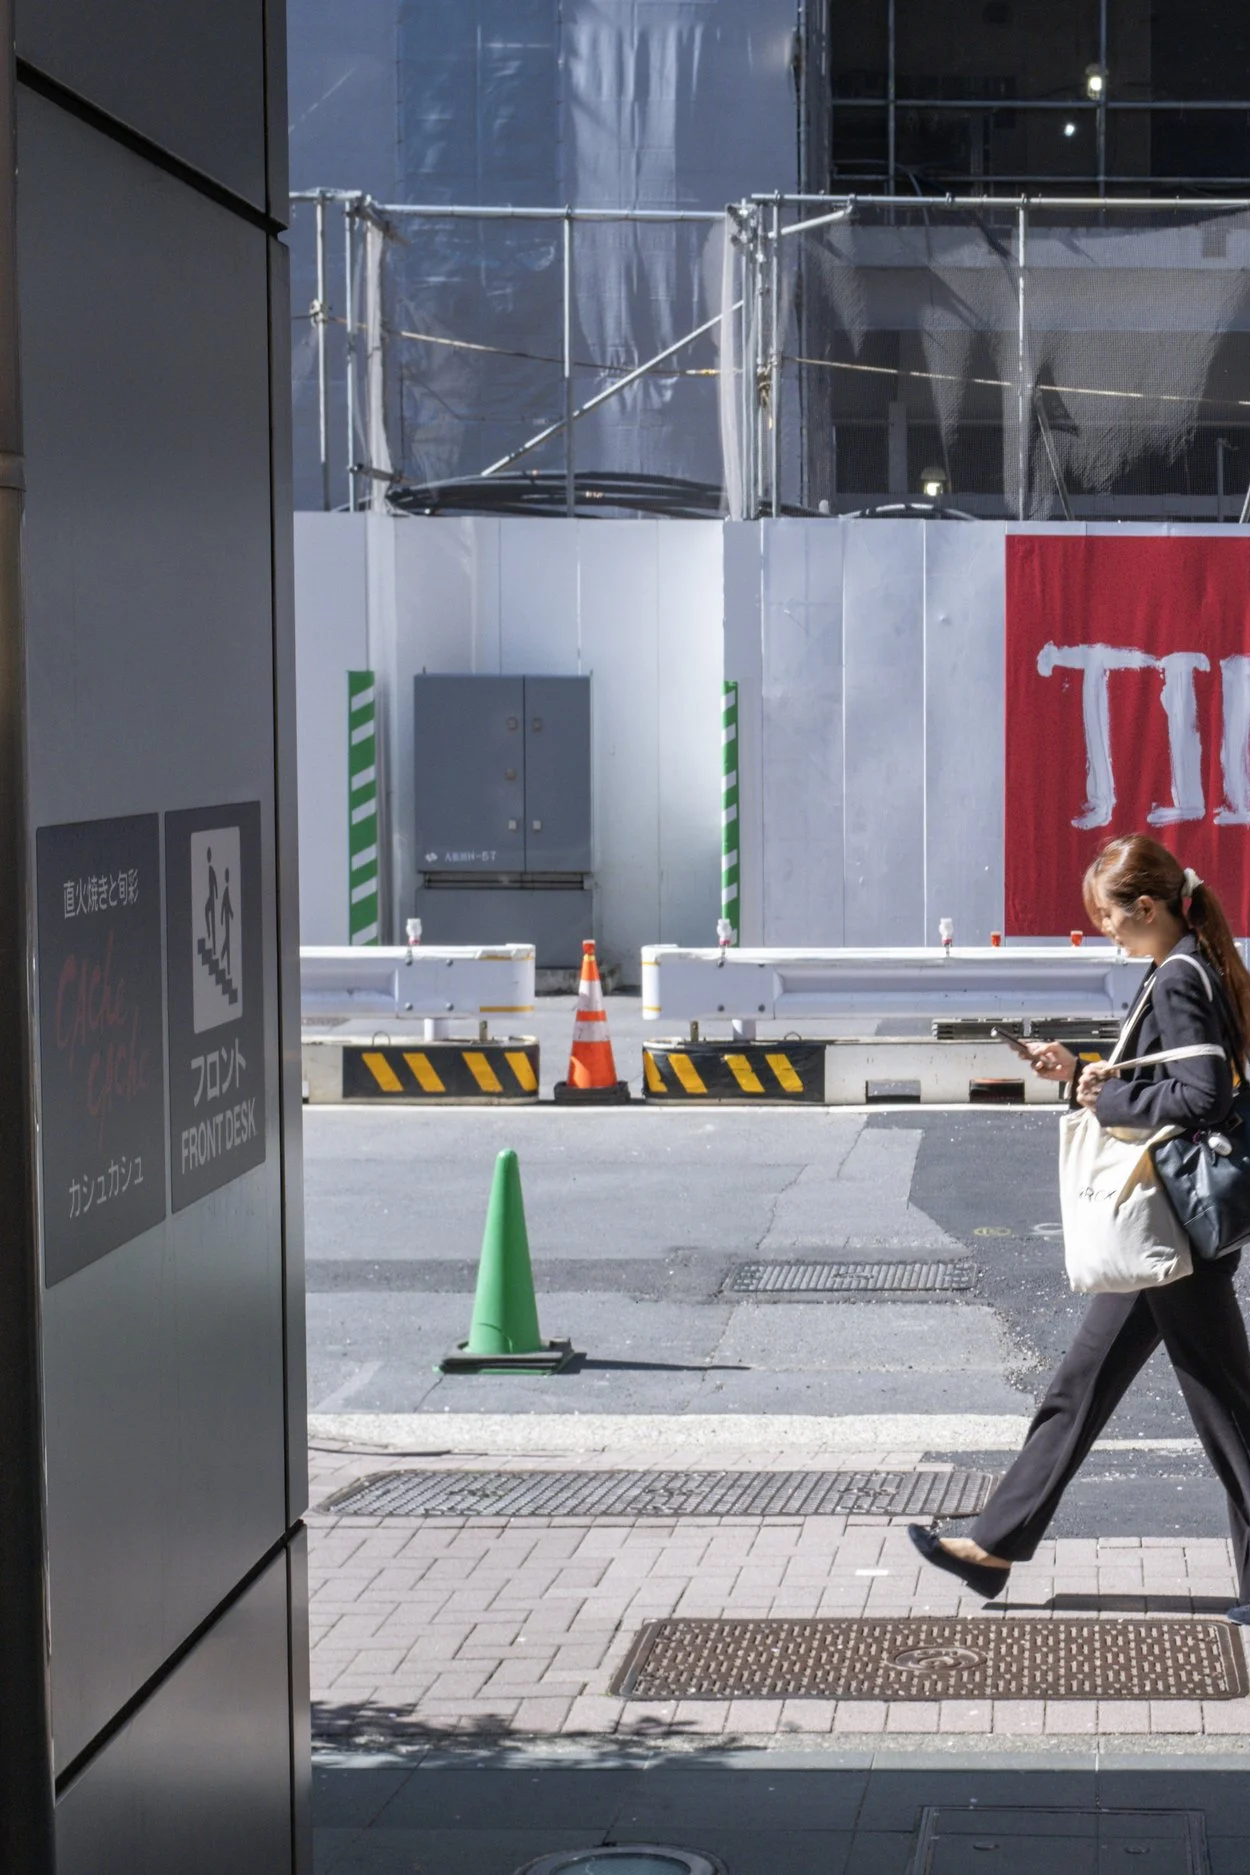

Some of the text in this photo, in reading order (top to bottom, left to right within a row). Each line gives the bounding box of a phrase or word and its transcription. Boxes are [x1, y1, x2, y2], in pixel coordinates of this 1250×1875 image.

[63, 868, 140, 919] 直火焼きと旬彩
[191, 1038, 247, 1107] フロント
[181, 1097, 257, 1175] FRONT DESK
[69, 1155, 144, 1219] カシュカシュ
